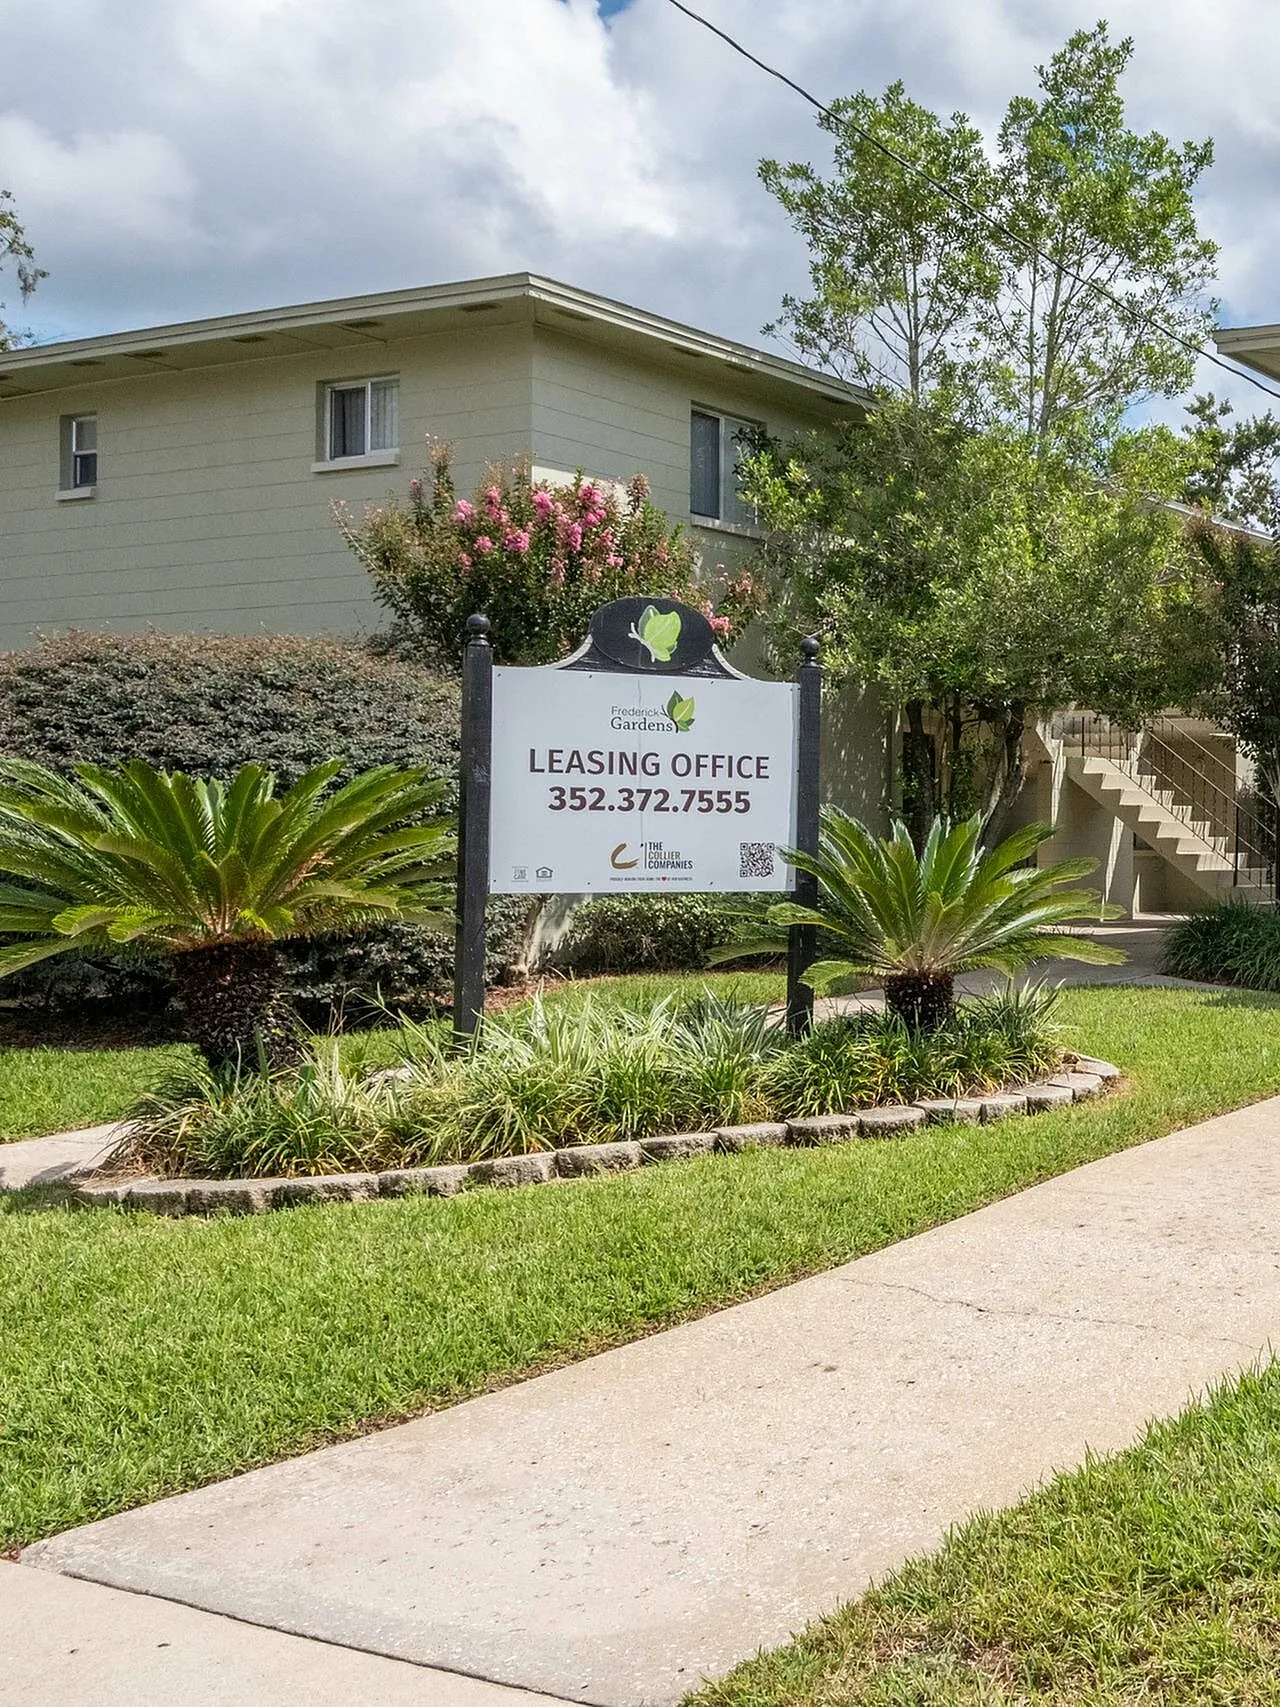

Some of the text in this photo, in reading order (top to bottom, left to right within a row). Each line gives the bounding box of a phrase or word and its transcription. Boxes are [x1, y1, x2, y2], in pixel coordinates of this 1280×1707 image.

[611, 705, 659, 718] Frederick
[610, 717, 673, 732] Gardens
[529, 748, 770, 779] LEASING OFFICE
[548, 786, 751, 814] 352.372.7555
[648, 841, 664, 851] THE
[648, 851, 681, 861] COLLIER
[648, 860, 694, 870] COMPANIES
